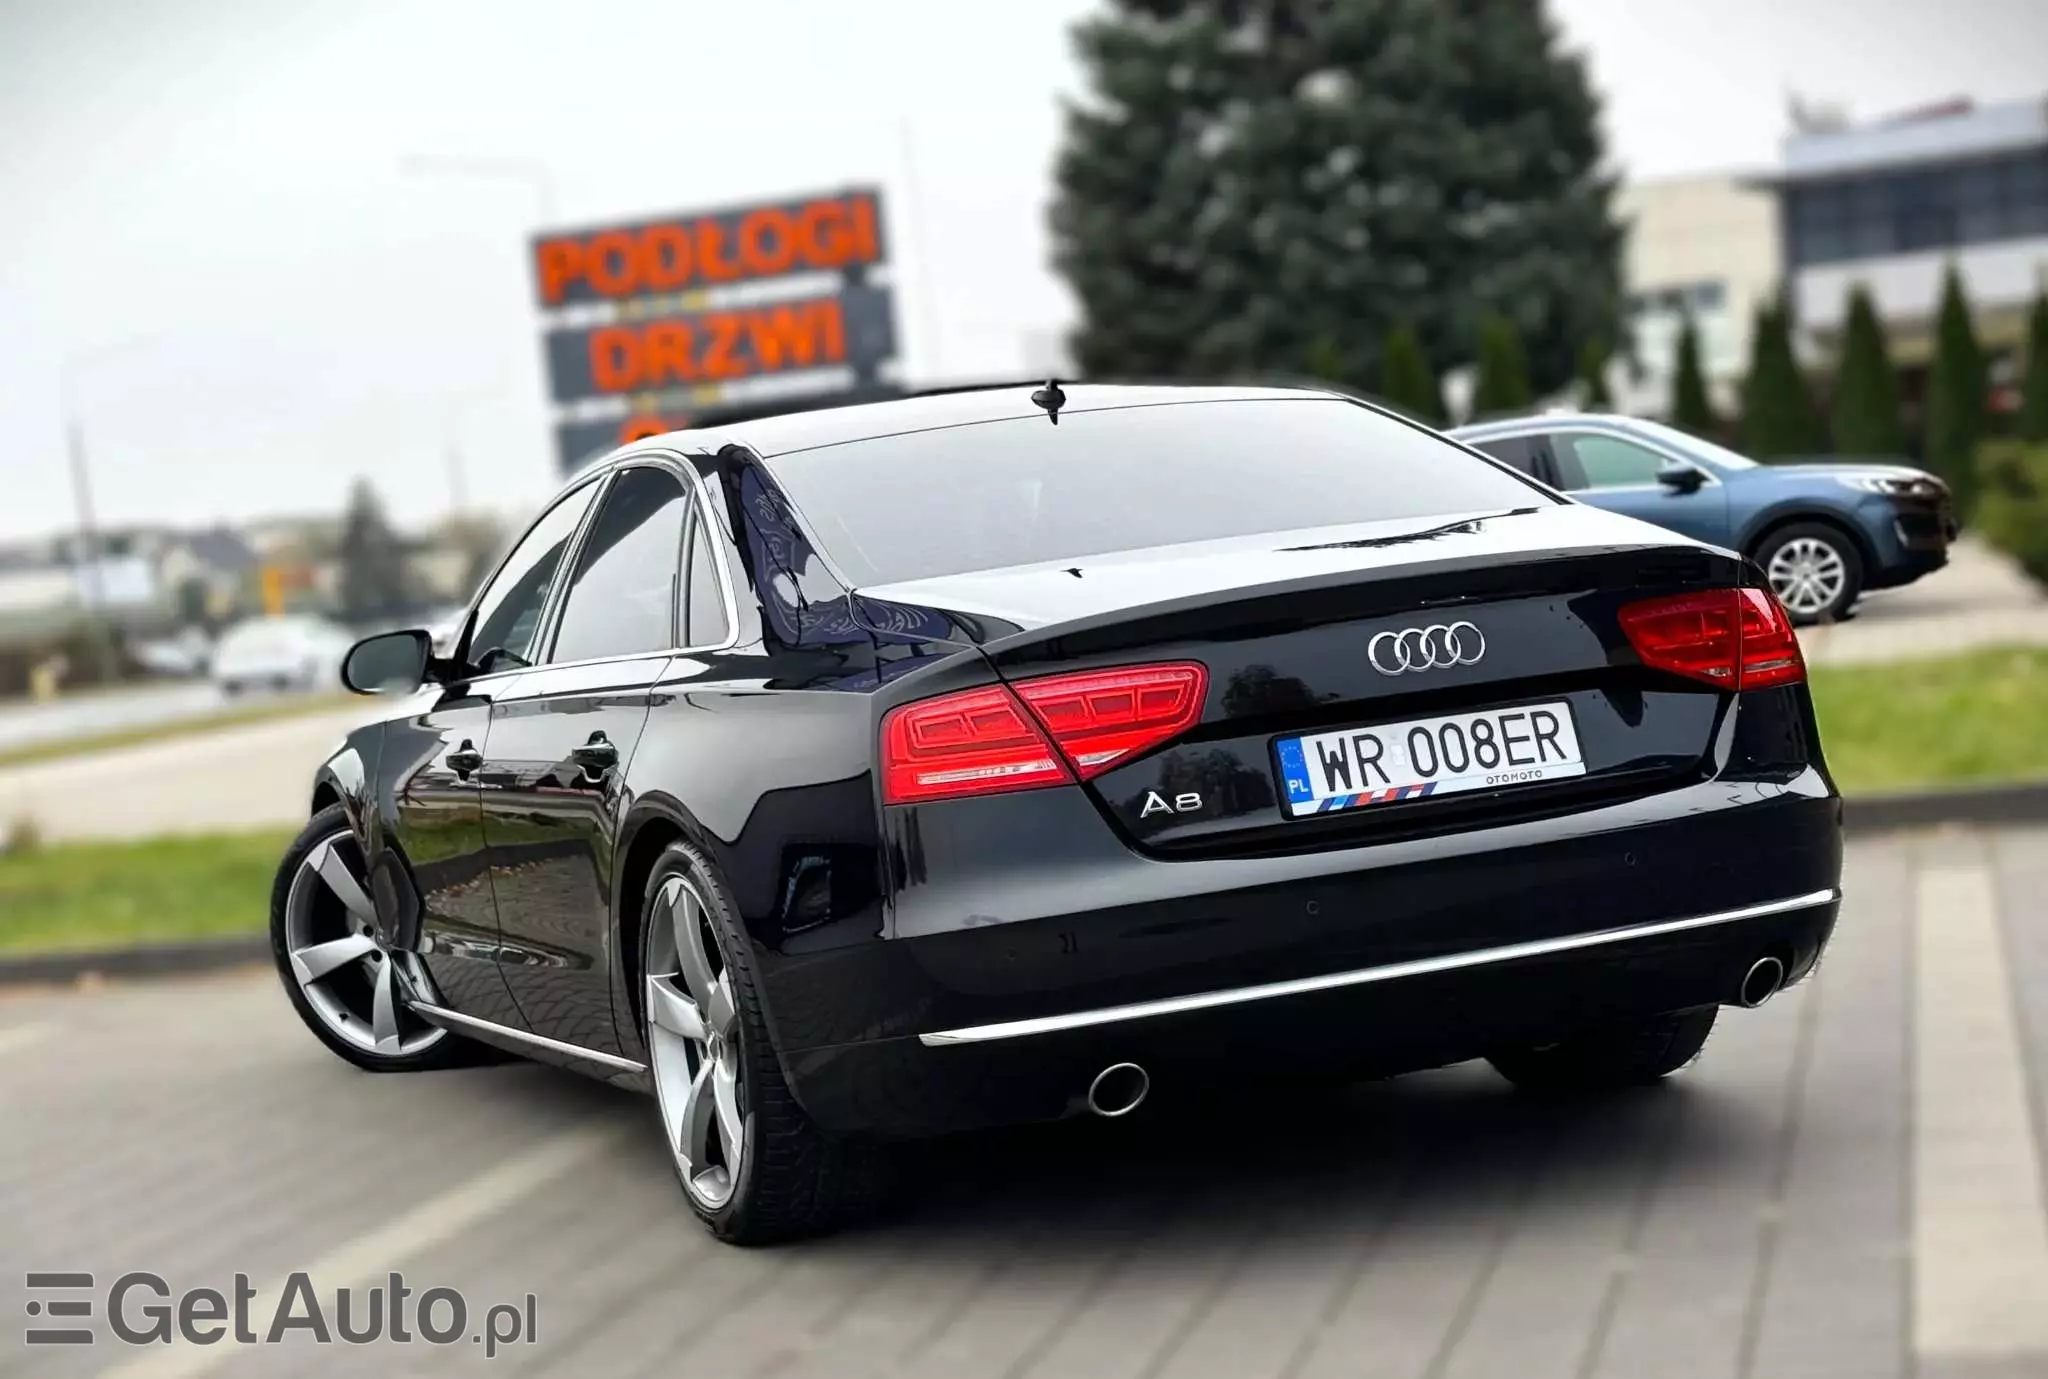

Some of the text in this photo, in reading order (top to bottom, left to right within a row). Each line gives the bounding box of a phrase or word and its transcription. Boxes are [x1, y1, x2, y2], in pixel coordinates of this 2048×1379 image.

[589, 301, 845, 391] DRZWI
[1315, 710, 1567, 793] WR 008ER
[1288, 779, 1309, 795] PL
[1485, 769, 1543, 785] OTOMOTO
[1140, 790, 1203, 820] A8
